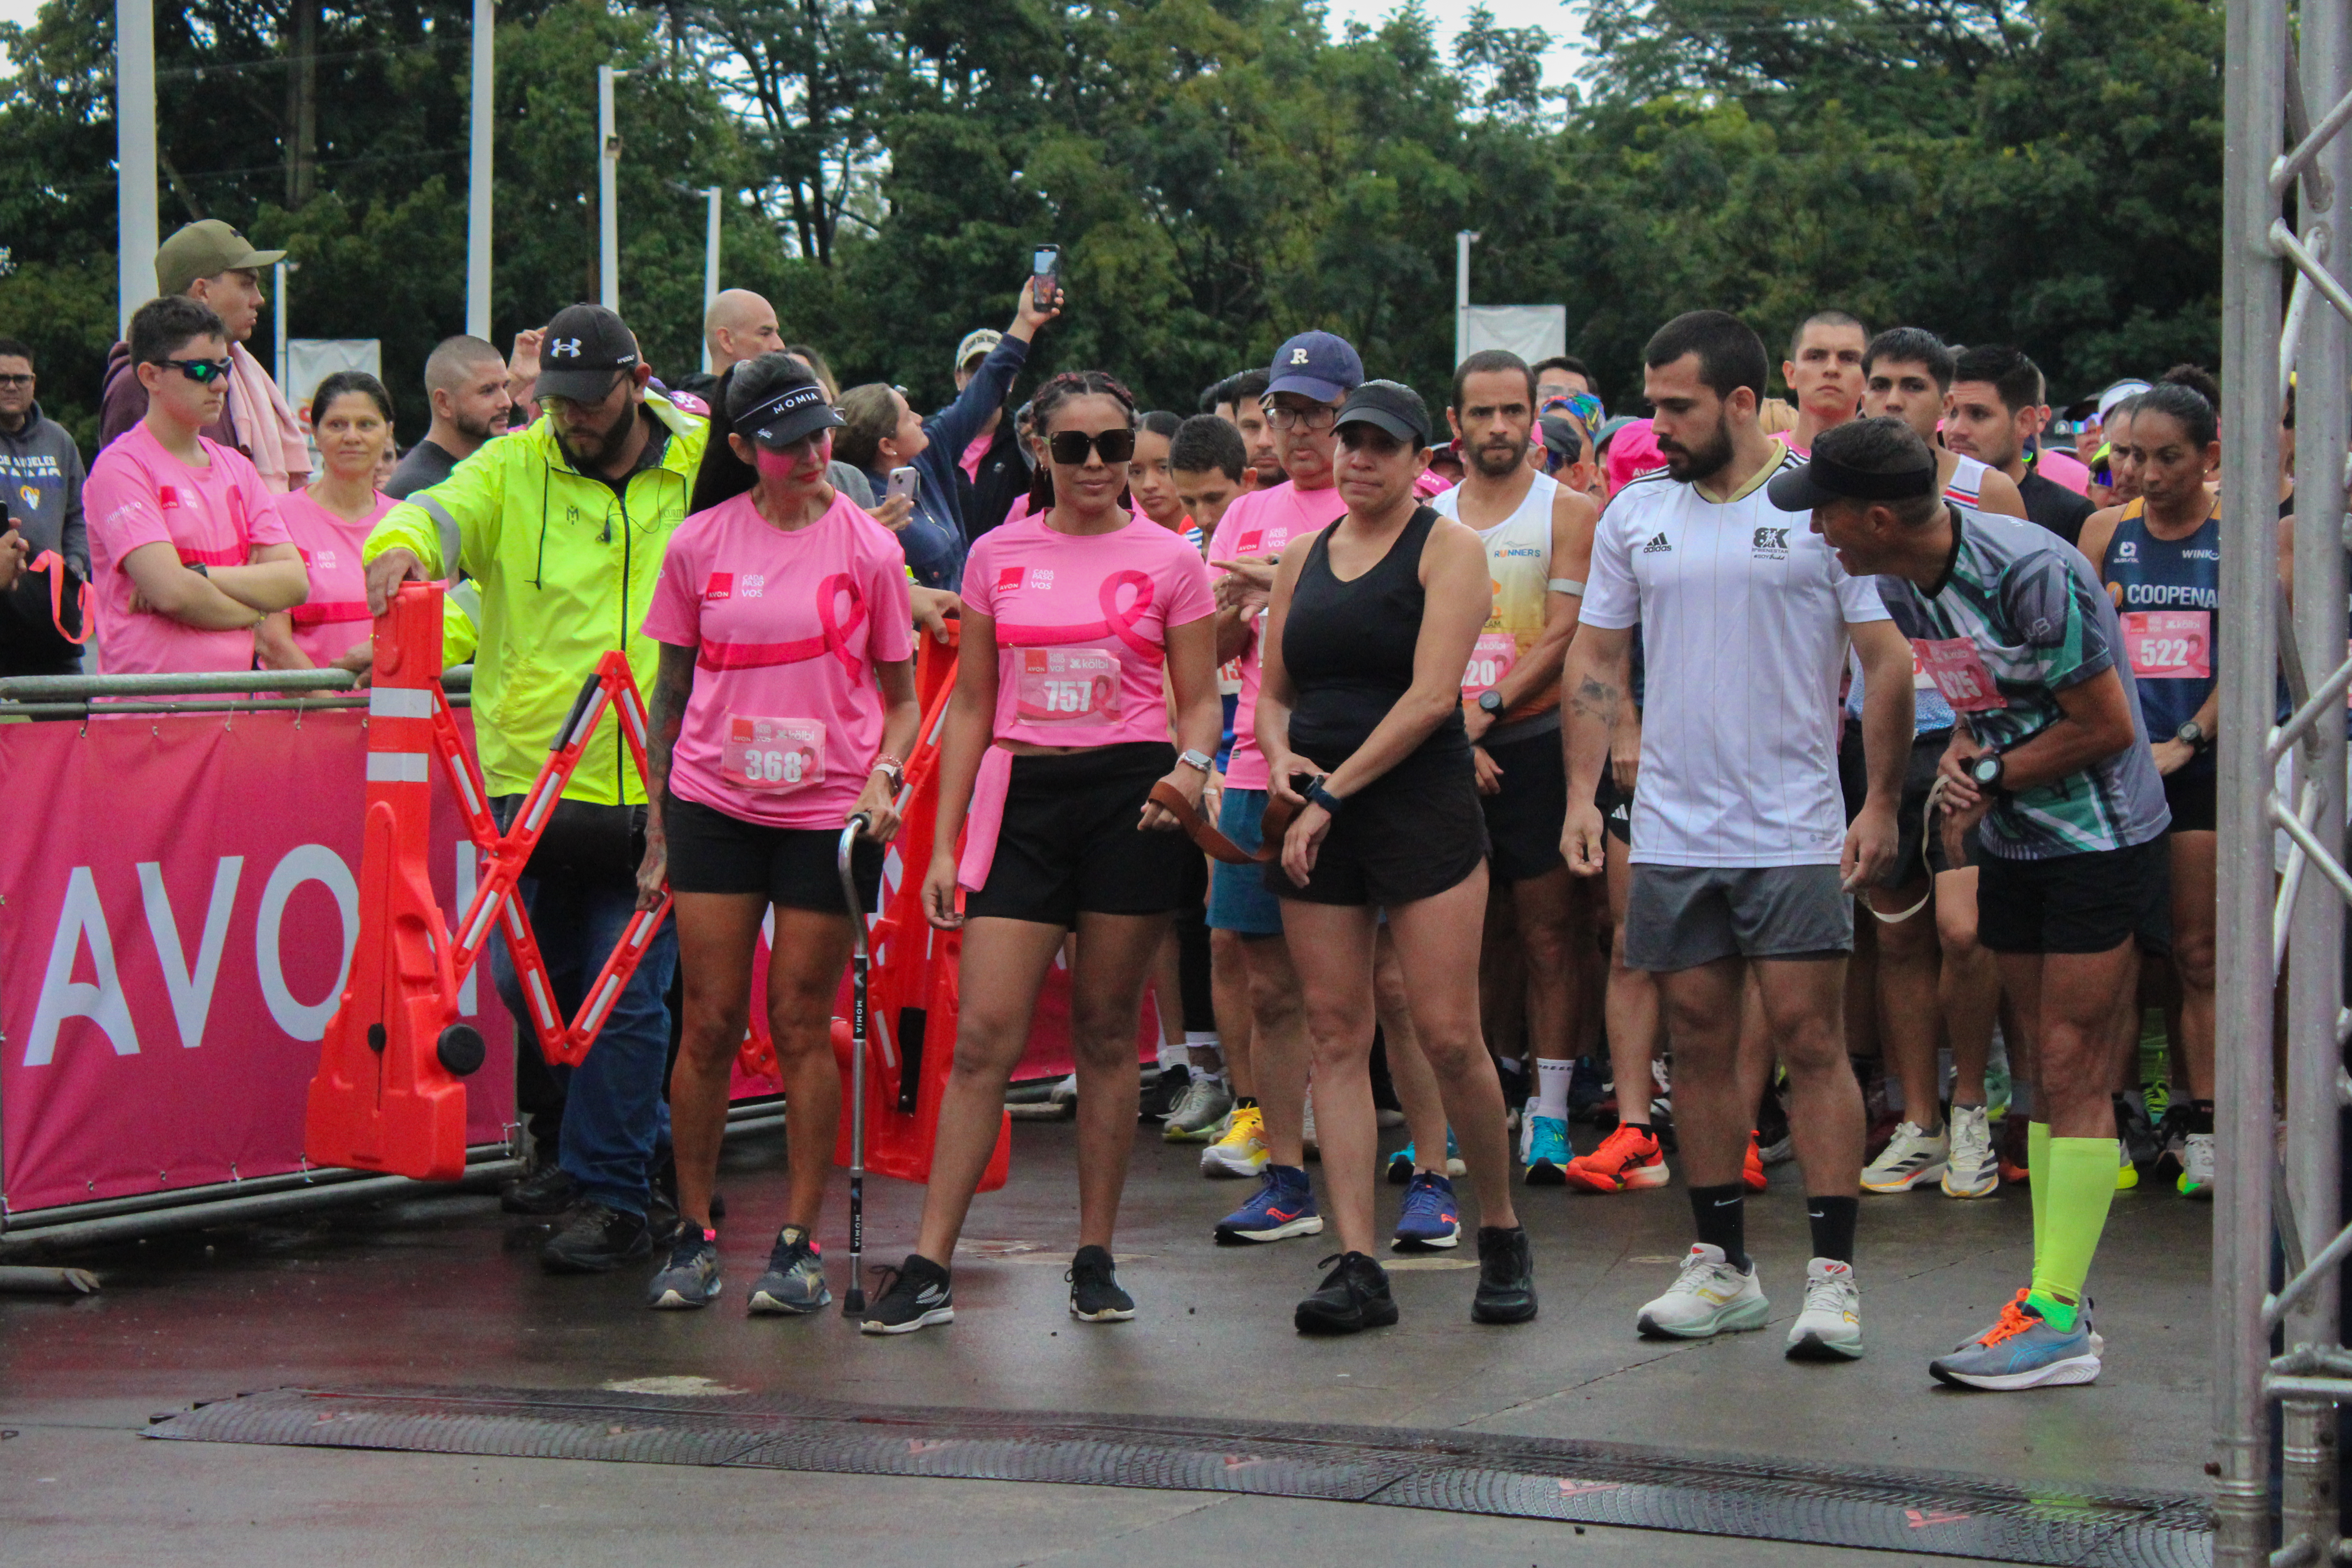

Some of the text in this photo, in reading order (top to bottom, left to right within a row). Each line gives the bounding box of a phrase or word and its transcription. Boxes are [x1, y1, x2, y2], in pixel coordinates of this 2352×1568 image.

[1290, 348, 1309, 365] R
[773, 392, 819, 414] MOMIA
[1268, 539, 1286, 548] VOS
[1643, 544, 1672, 554] adidas
[1494, 549, 1541, 558] RUNNERS
[1000, 583, 1019, 591] AVON
[1031, 581, 1052, 590] VOS
[742, 589, 763, 597] VOS
[2127, 584, 2218, 608] COOPENA
[2141, 639, 2189, 666] 522
[1083, 658, 1109, 669] kölbi
[1461, 660, 1496, 687] 20
[1938, 670, 1982, 699] 625
[1044, 680, 1093, 712] 757
[789, 730, 815, 741] kölbi
[745, 750, 803, 783] 368
